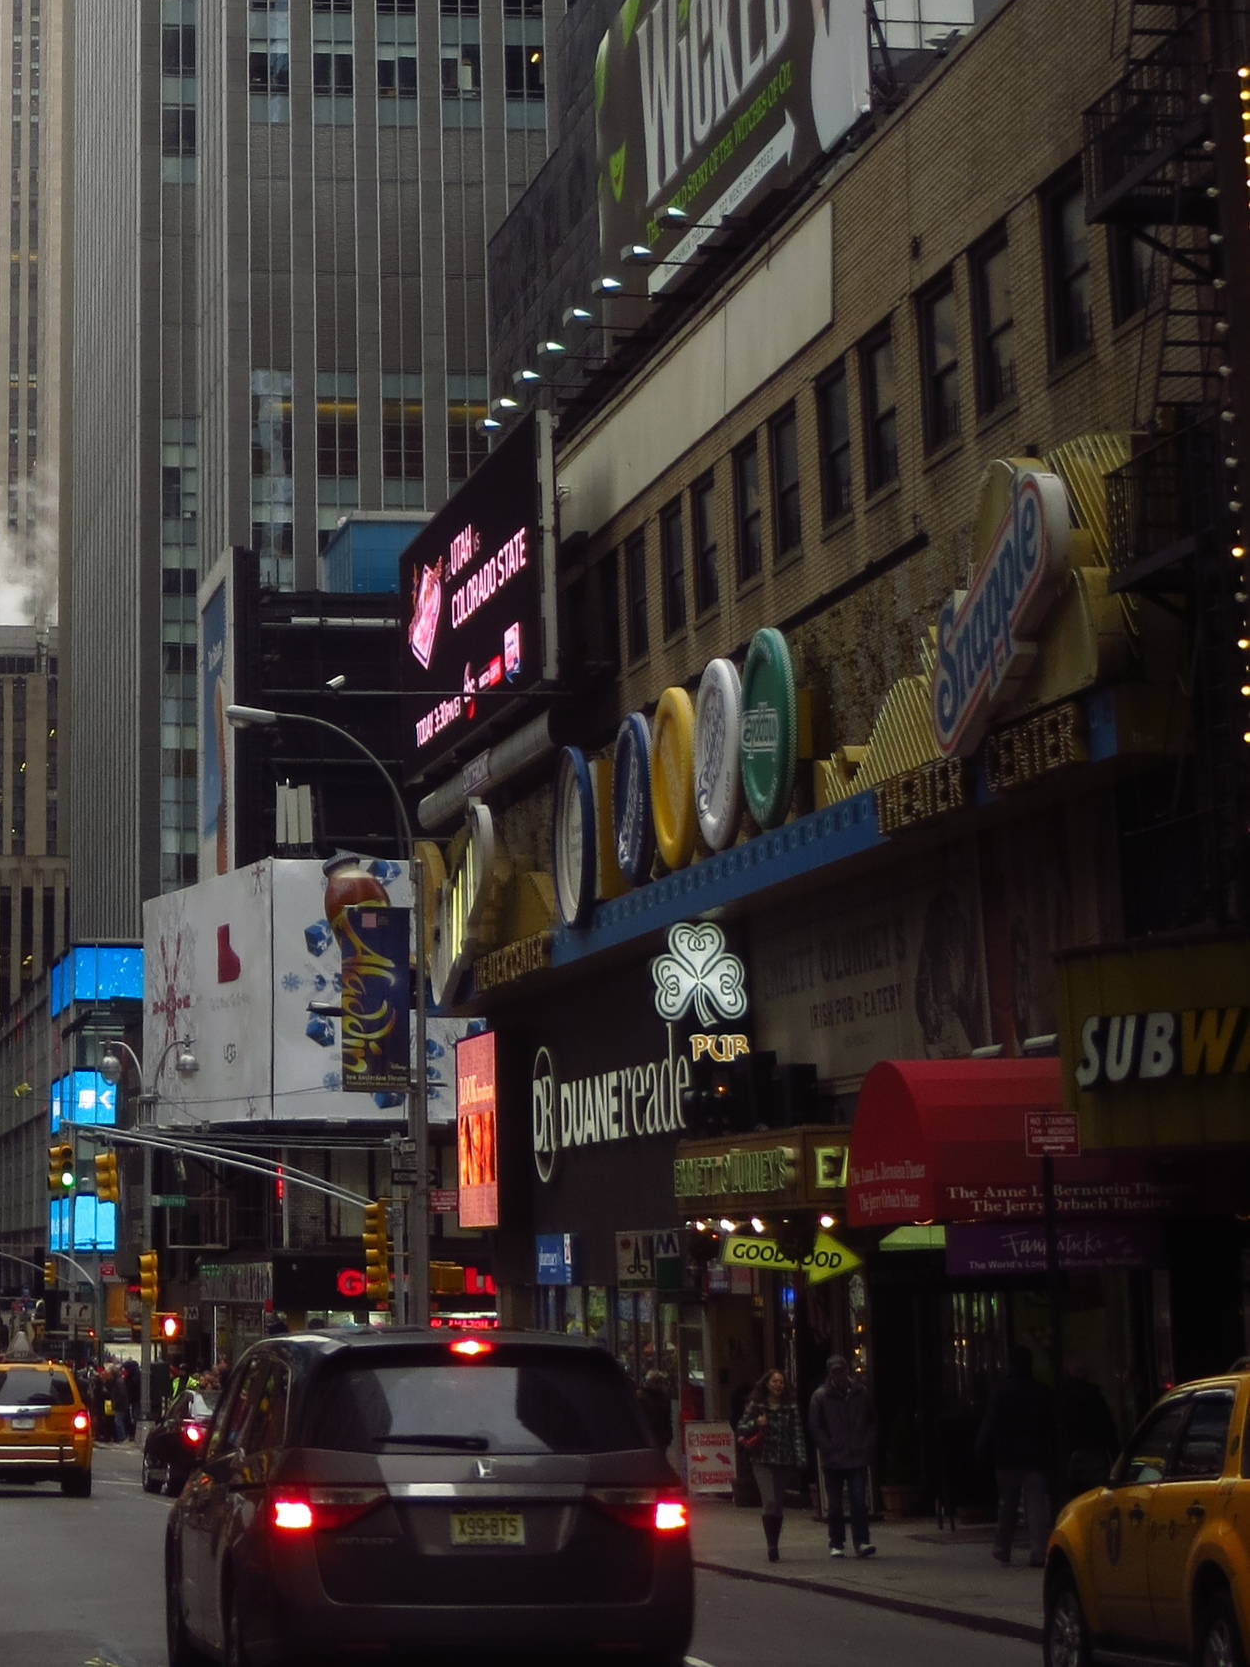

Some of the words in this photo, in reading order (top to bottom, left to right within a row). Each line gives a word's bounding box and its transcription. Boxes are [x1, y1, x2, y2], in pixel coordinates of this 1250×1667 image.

[450, 523, 472, 576] UTAH
[451, 556, 497, 630] COLORADO
[496, 526, 526, 588] STATE
[937, 472, 1041, 734] Snapple
[415, 710, 434, 749] TODAY
[877, 757, 962, 834] THEATER
[985, 701, 1076, 793] CENTER
[809, 1000, 835, 1030] IRISH
[835, 996, 855, 1024] PUB
[863, 982, 904, 1019] EATERY
[688, 1033, 750, 1063] PUB
[532, 1074, 557, 1154] DR
[1029, 1116, 1041, 1126] NO
[1043, 1116, 1076, 1126] STANDING
[1047, 1126, 1076, 1136] MIDNIGHT
[905, 1160, 926, 1180] Theater
[899, 1188, 921, 1209] Theater
[946, 1186, 979, 1200] The
[982, 1186, 1028, 1199] Anne
[1052, 1183, 1130, 1197] Bernstein
[970, 1199, 1000, 1212] The
[1002, 1199, 1044, 1215] Jerry
[1108, 1196, 1172, 1209] Theater
[732, 1243, 788, 1264] GOOD
[968, 1260, 987, 1270] The
[988, 1260, 1024, 1270] World's
